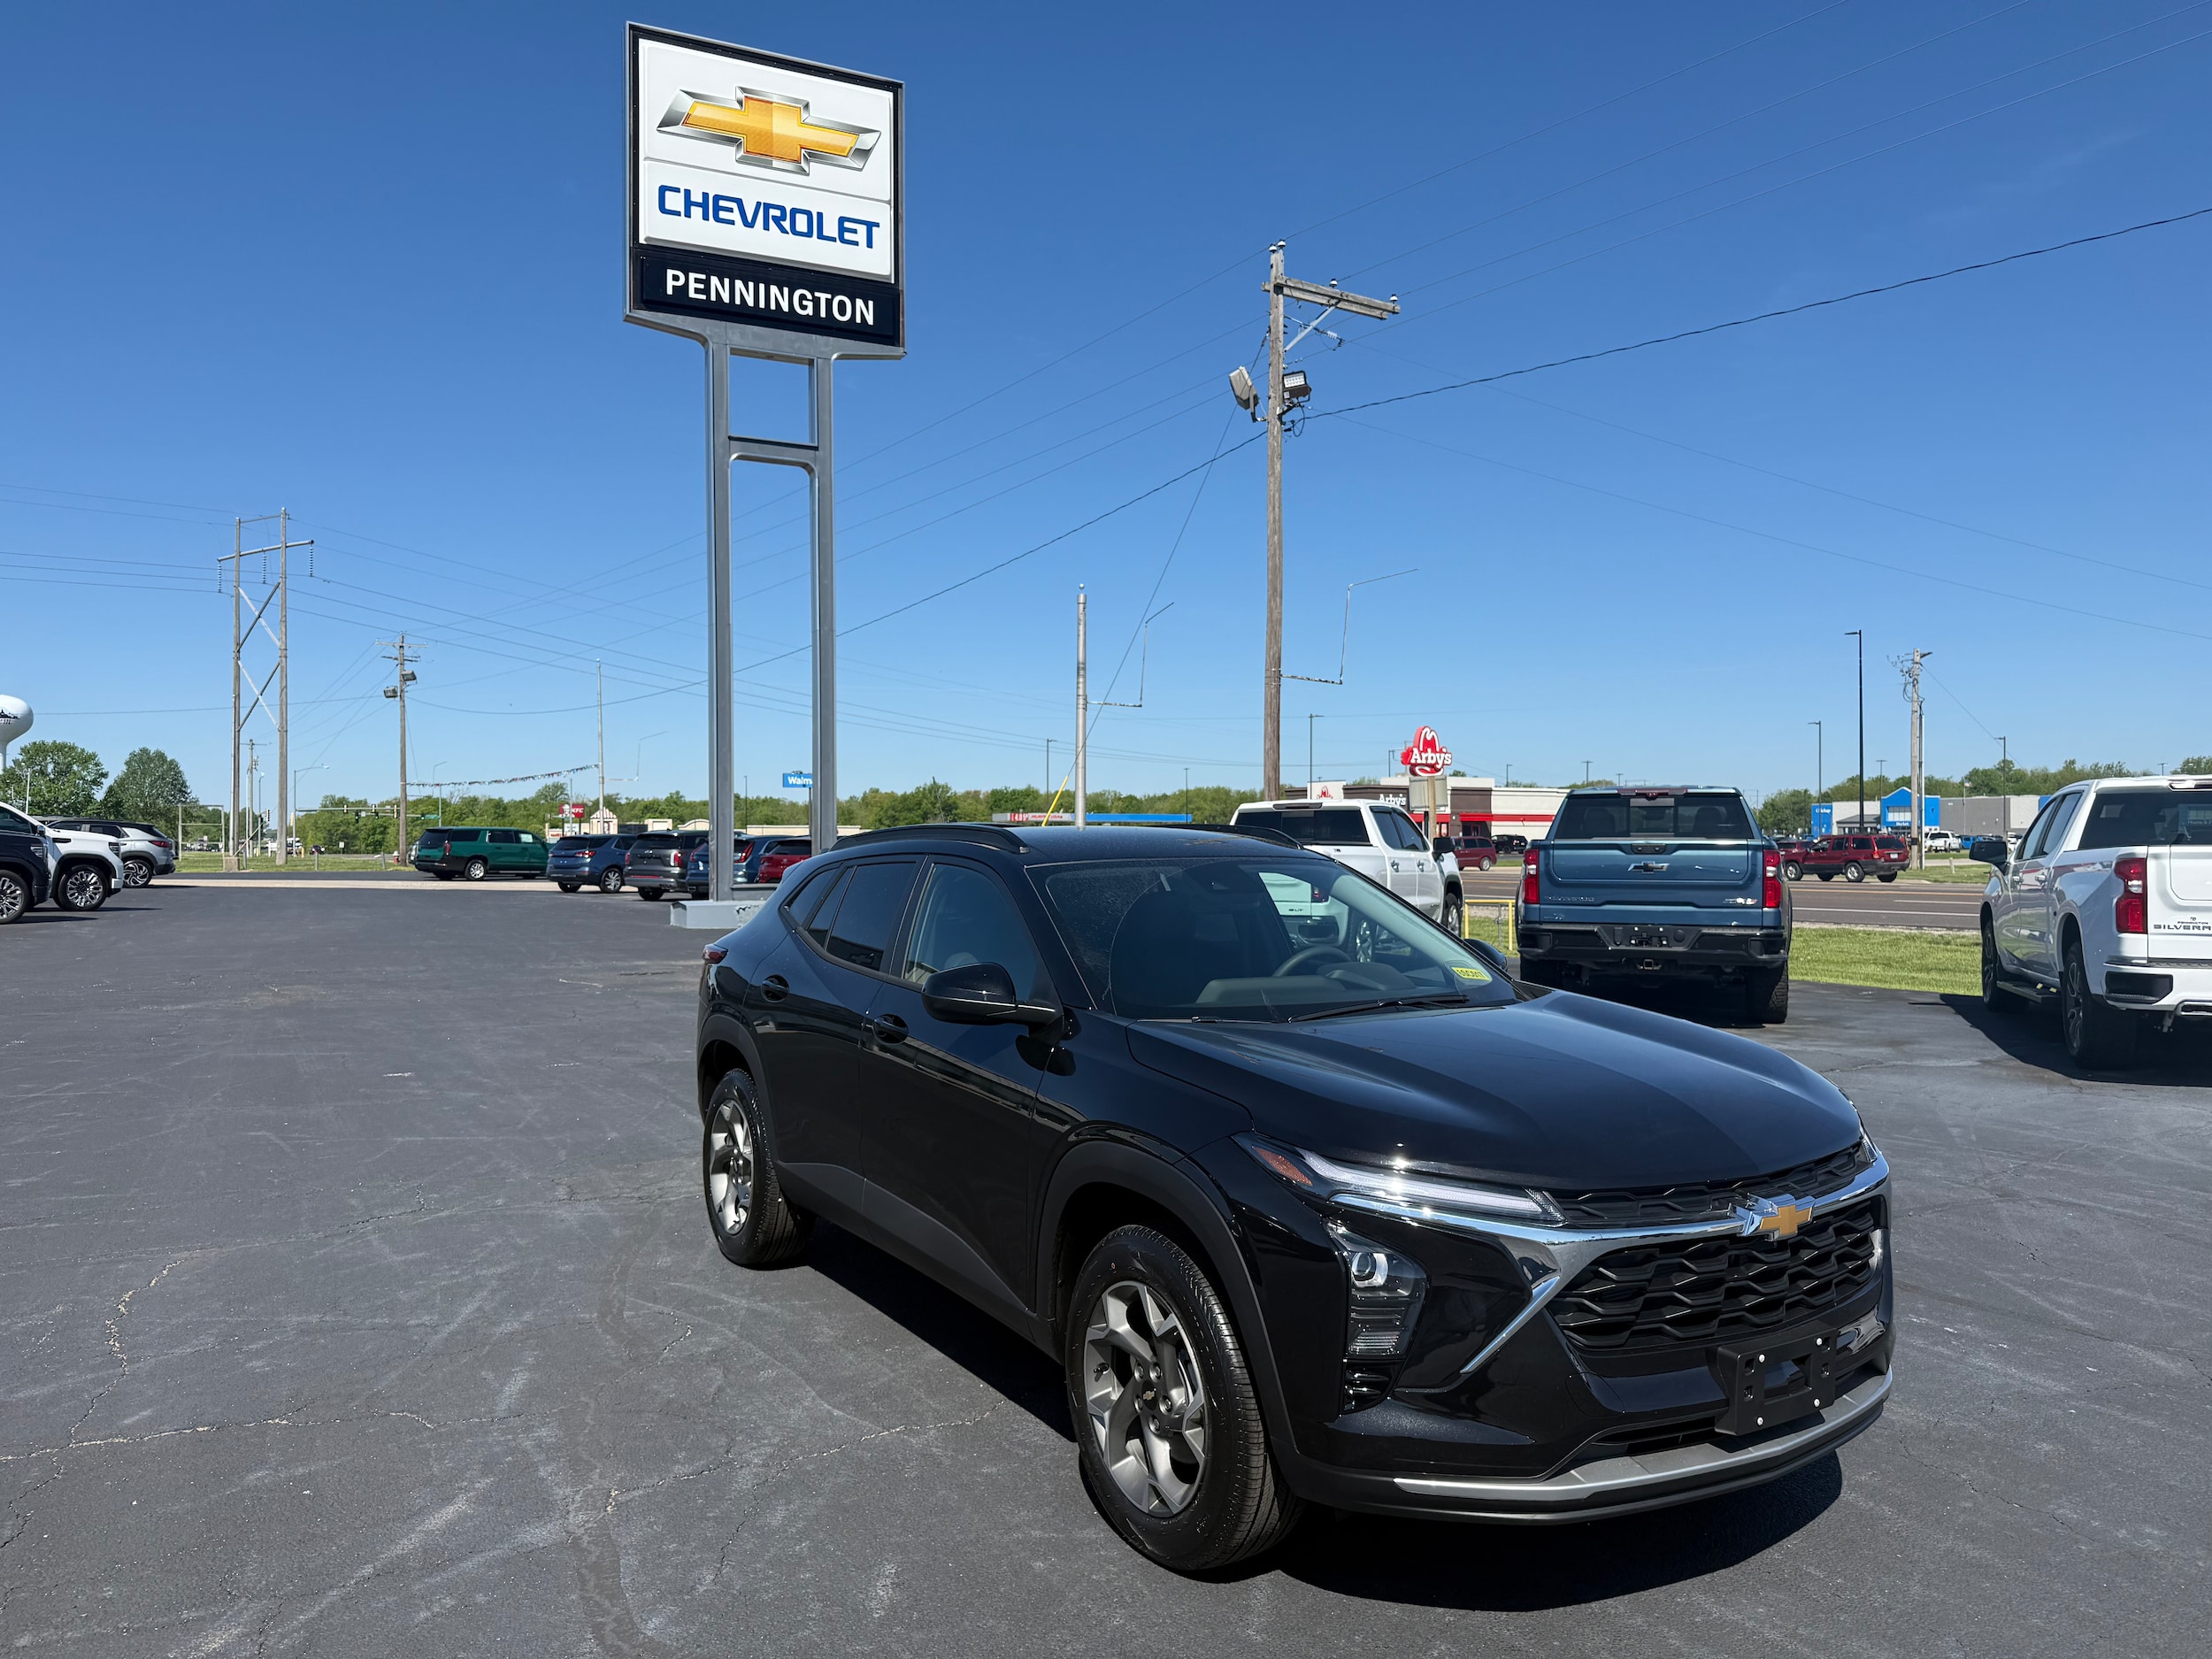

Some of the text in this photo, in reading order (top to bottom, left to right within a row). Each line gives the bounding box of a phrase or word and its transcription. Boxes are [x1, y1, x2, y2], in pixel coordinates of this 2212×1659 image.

[658, 185, 880, 250] CHEVROLET
[666, 268, 875, 326] PENNINGTON
[1410, 748, 1452, 769] Arby's
[1379, 794, 1407, 807] Arby's
